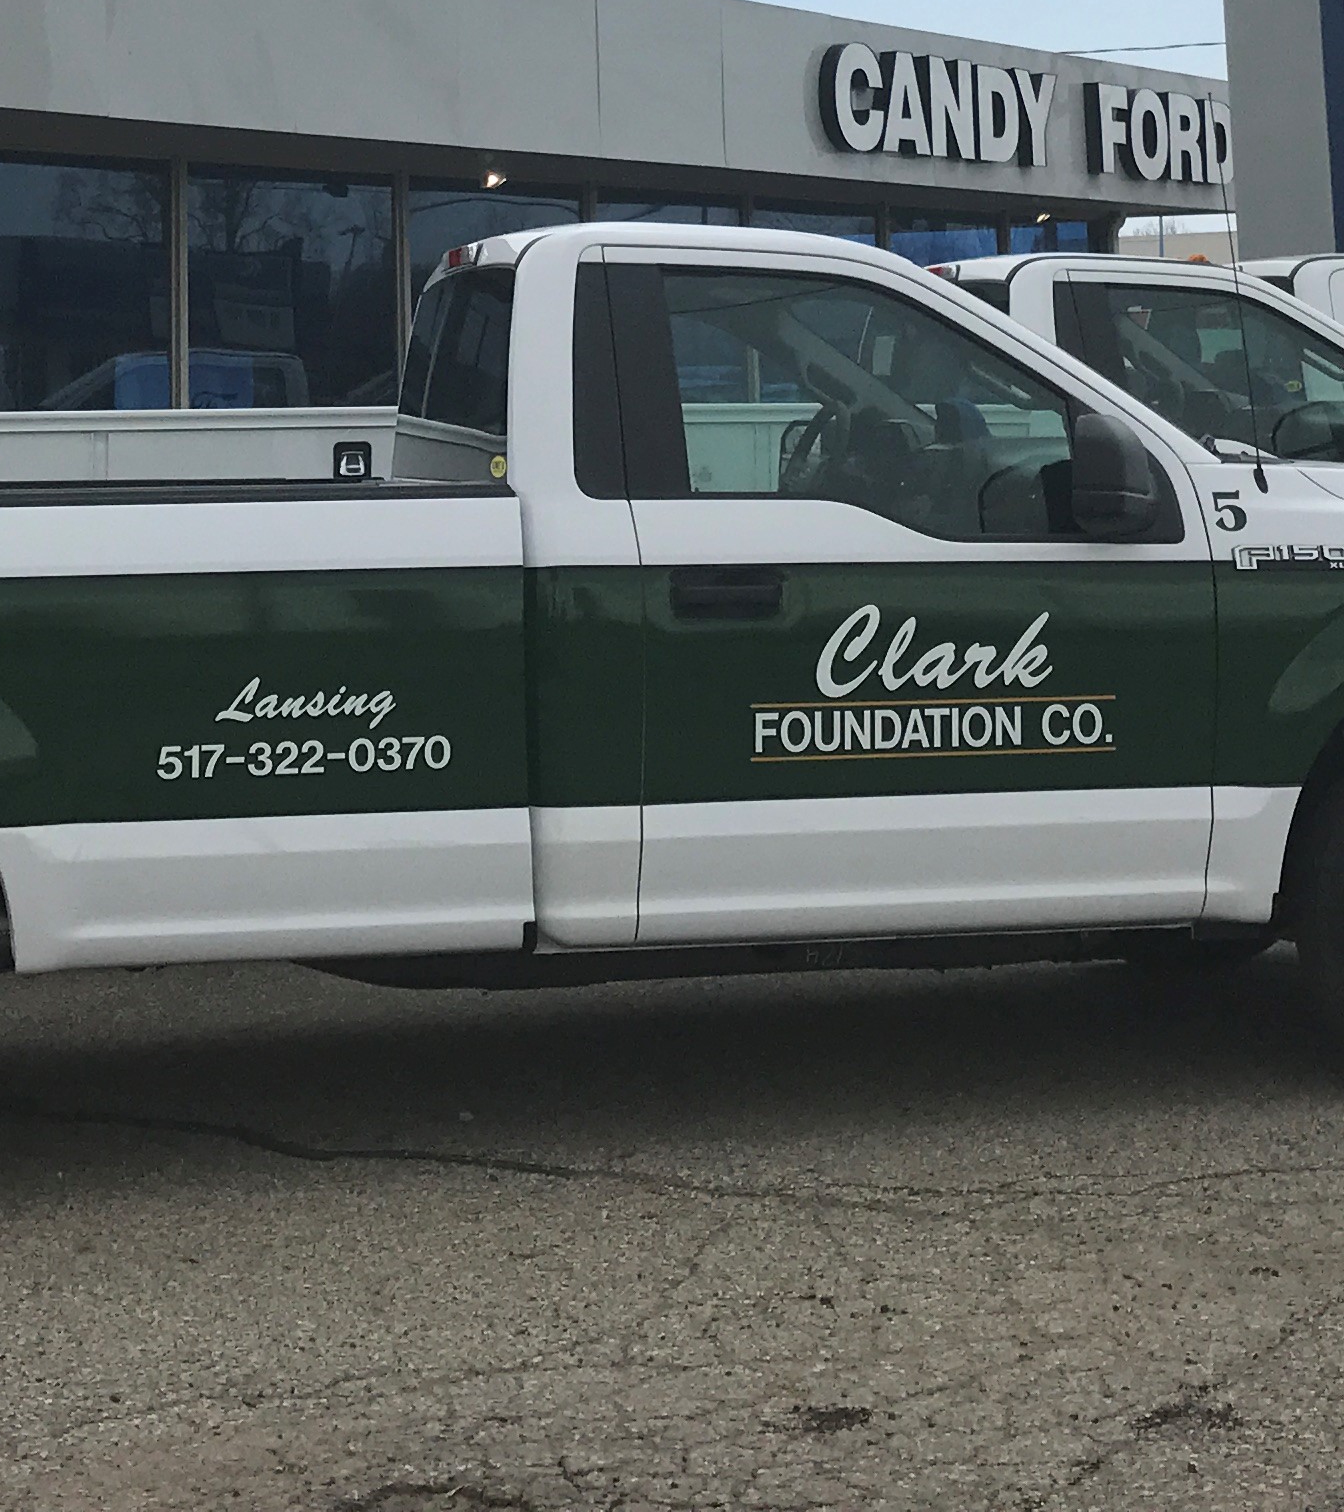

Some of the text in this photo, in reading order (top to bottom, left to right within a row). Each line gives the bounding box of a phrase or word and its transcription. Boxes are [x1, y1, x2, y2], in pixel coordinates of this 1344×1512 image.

[826, 41, 1234, 184] CANDY FORD
[1211, 489, 1248, 532] 5
[816, 604, 1053, 698] Clark
[215, 677, 396, 729] Lansing
[755, 702, 1113, 753] FOUNDATION CO.
[156, 734, 451, 781] 517-322-0370
